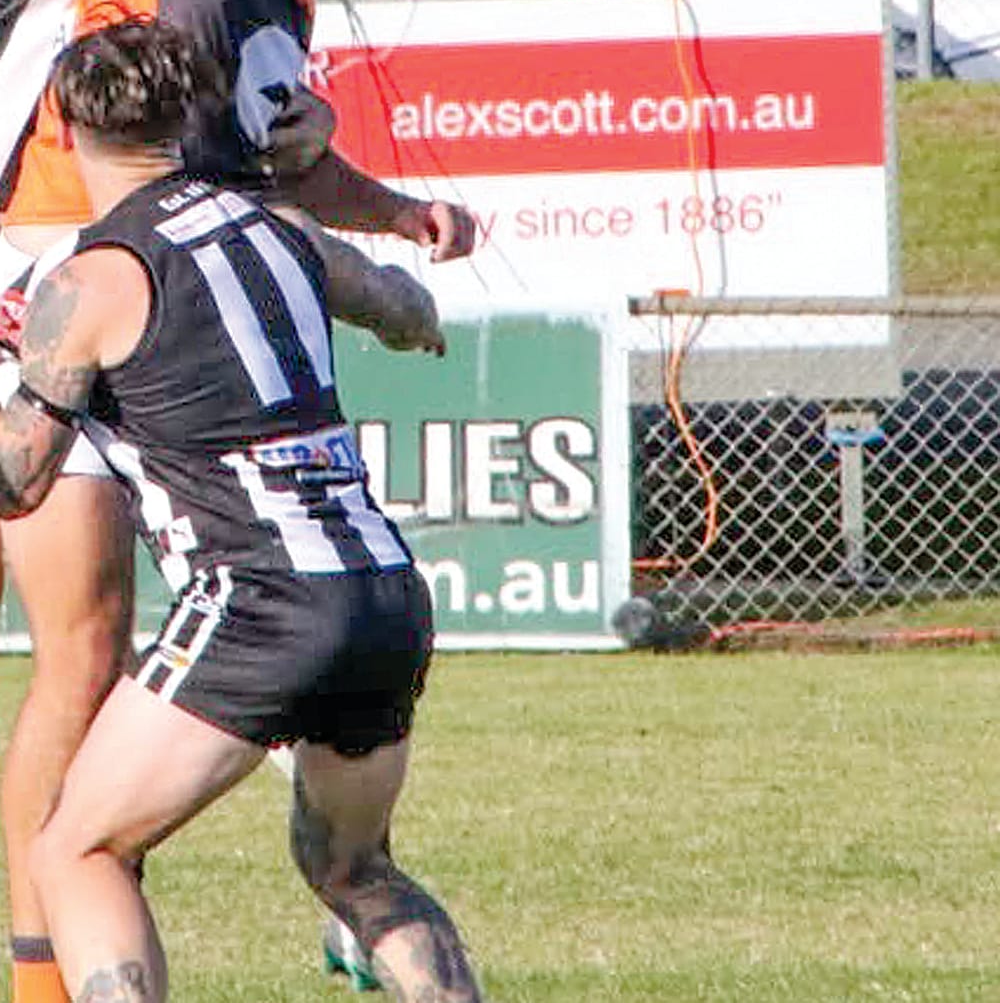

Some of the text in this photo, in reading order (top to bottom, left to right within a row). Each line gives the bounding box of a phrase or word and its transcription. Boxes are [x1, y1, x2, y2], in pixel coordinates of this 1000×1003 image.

[391, 91, 815, 139] alexscott.com.au
[515, 199, 634, 239] since
[356, 416, 598, 525] LIES
